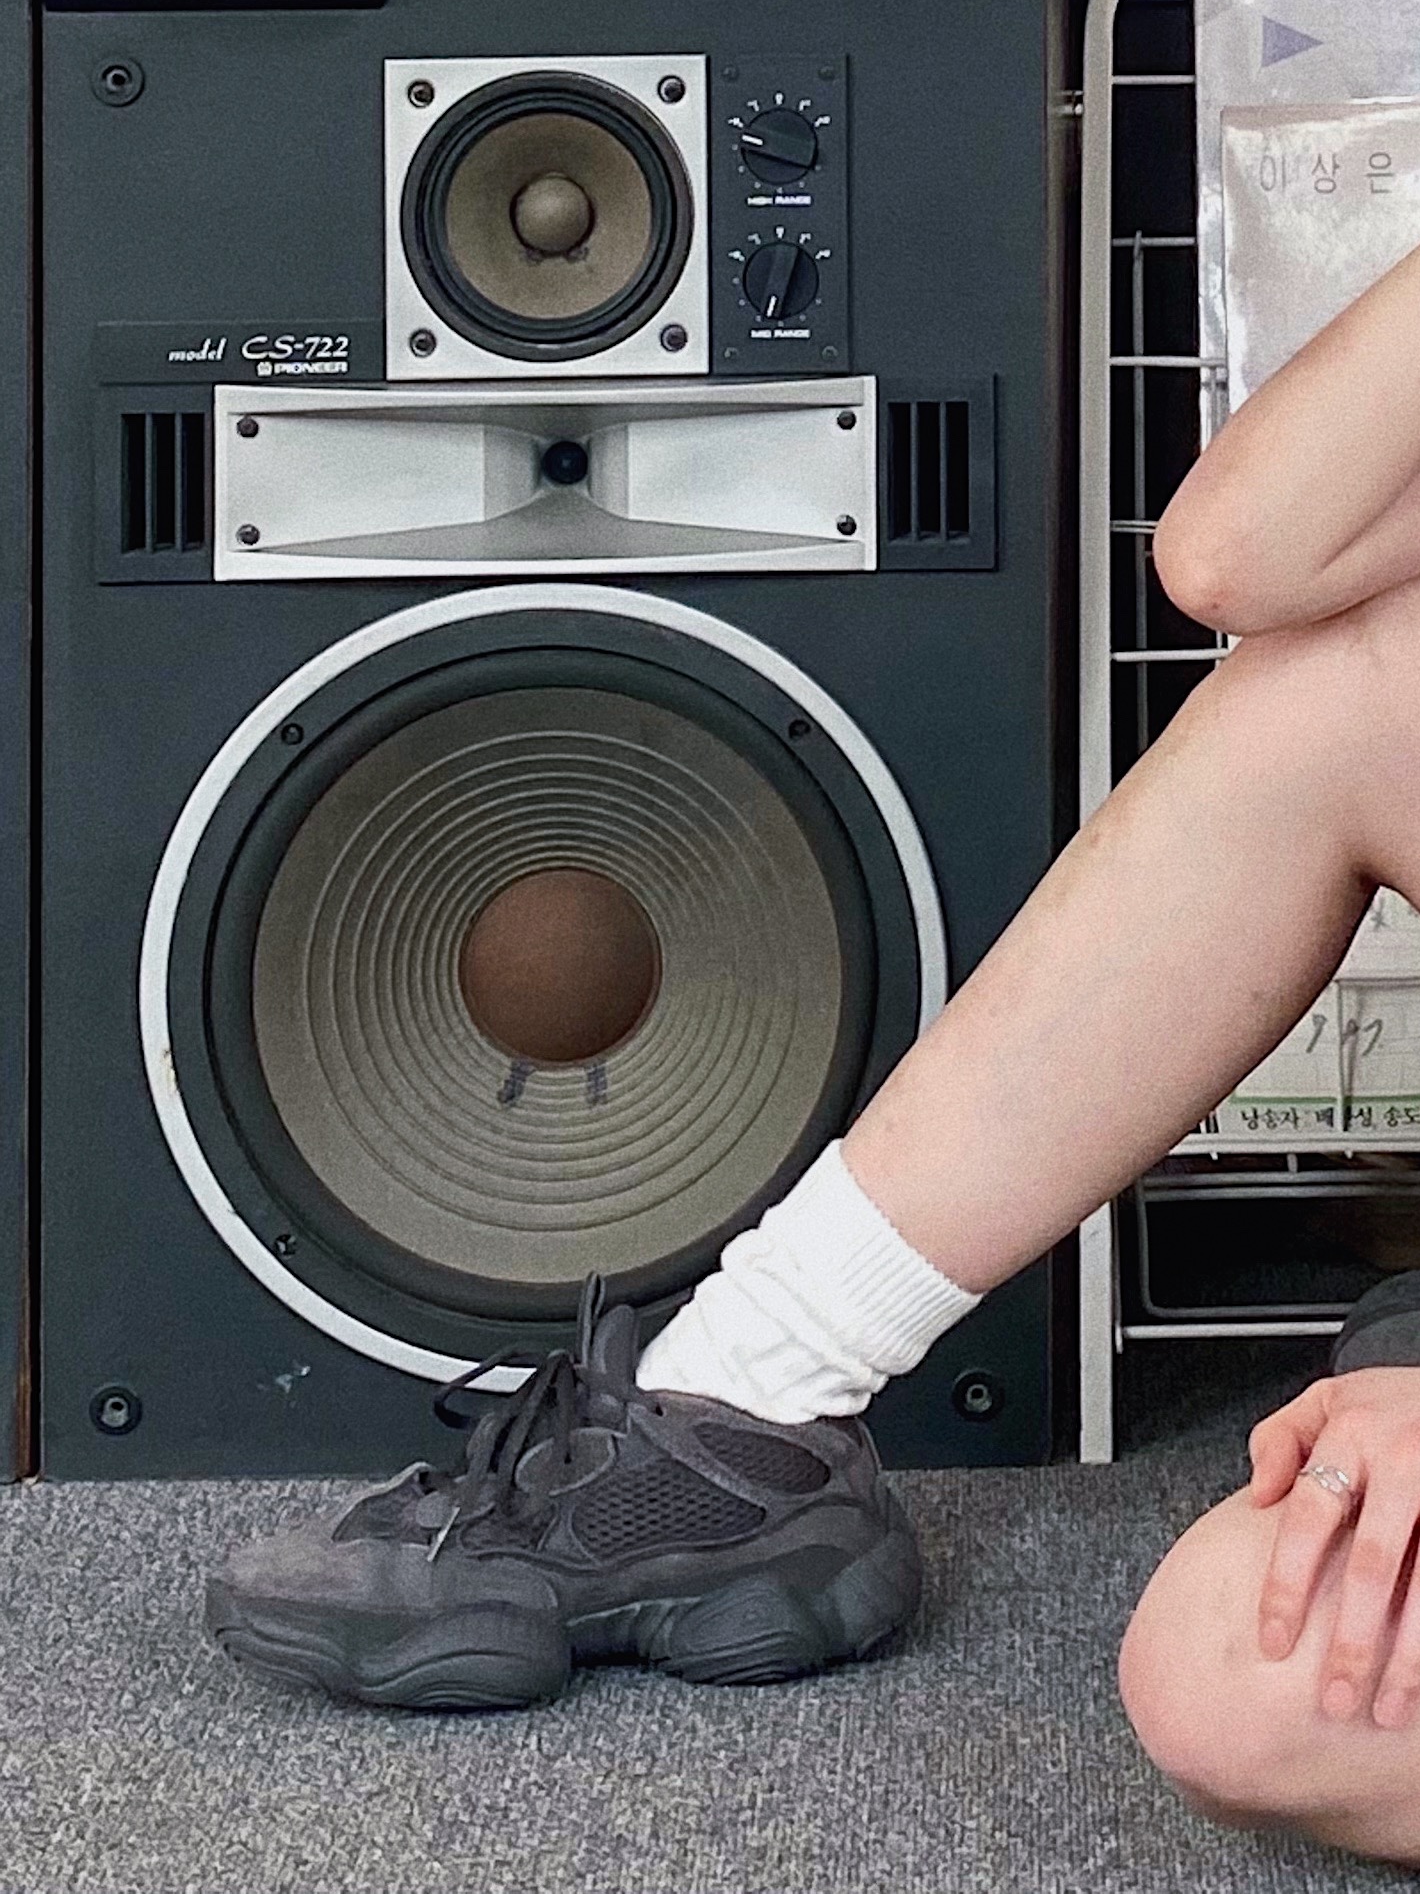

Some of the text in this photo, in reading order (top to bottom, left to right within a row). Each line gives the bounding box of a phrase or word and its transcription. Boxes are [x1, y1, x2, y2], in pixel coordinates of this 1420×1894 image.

[774, 329, 810, 338] RANGE
[168, 335, 349, 361] model CS-722
[274, 362, 348, 374] PIONEER
